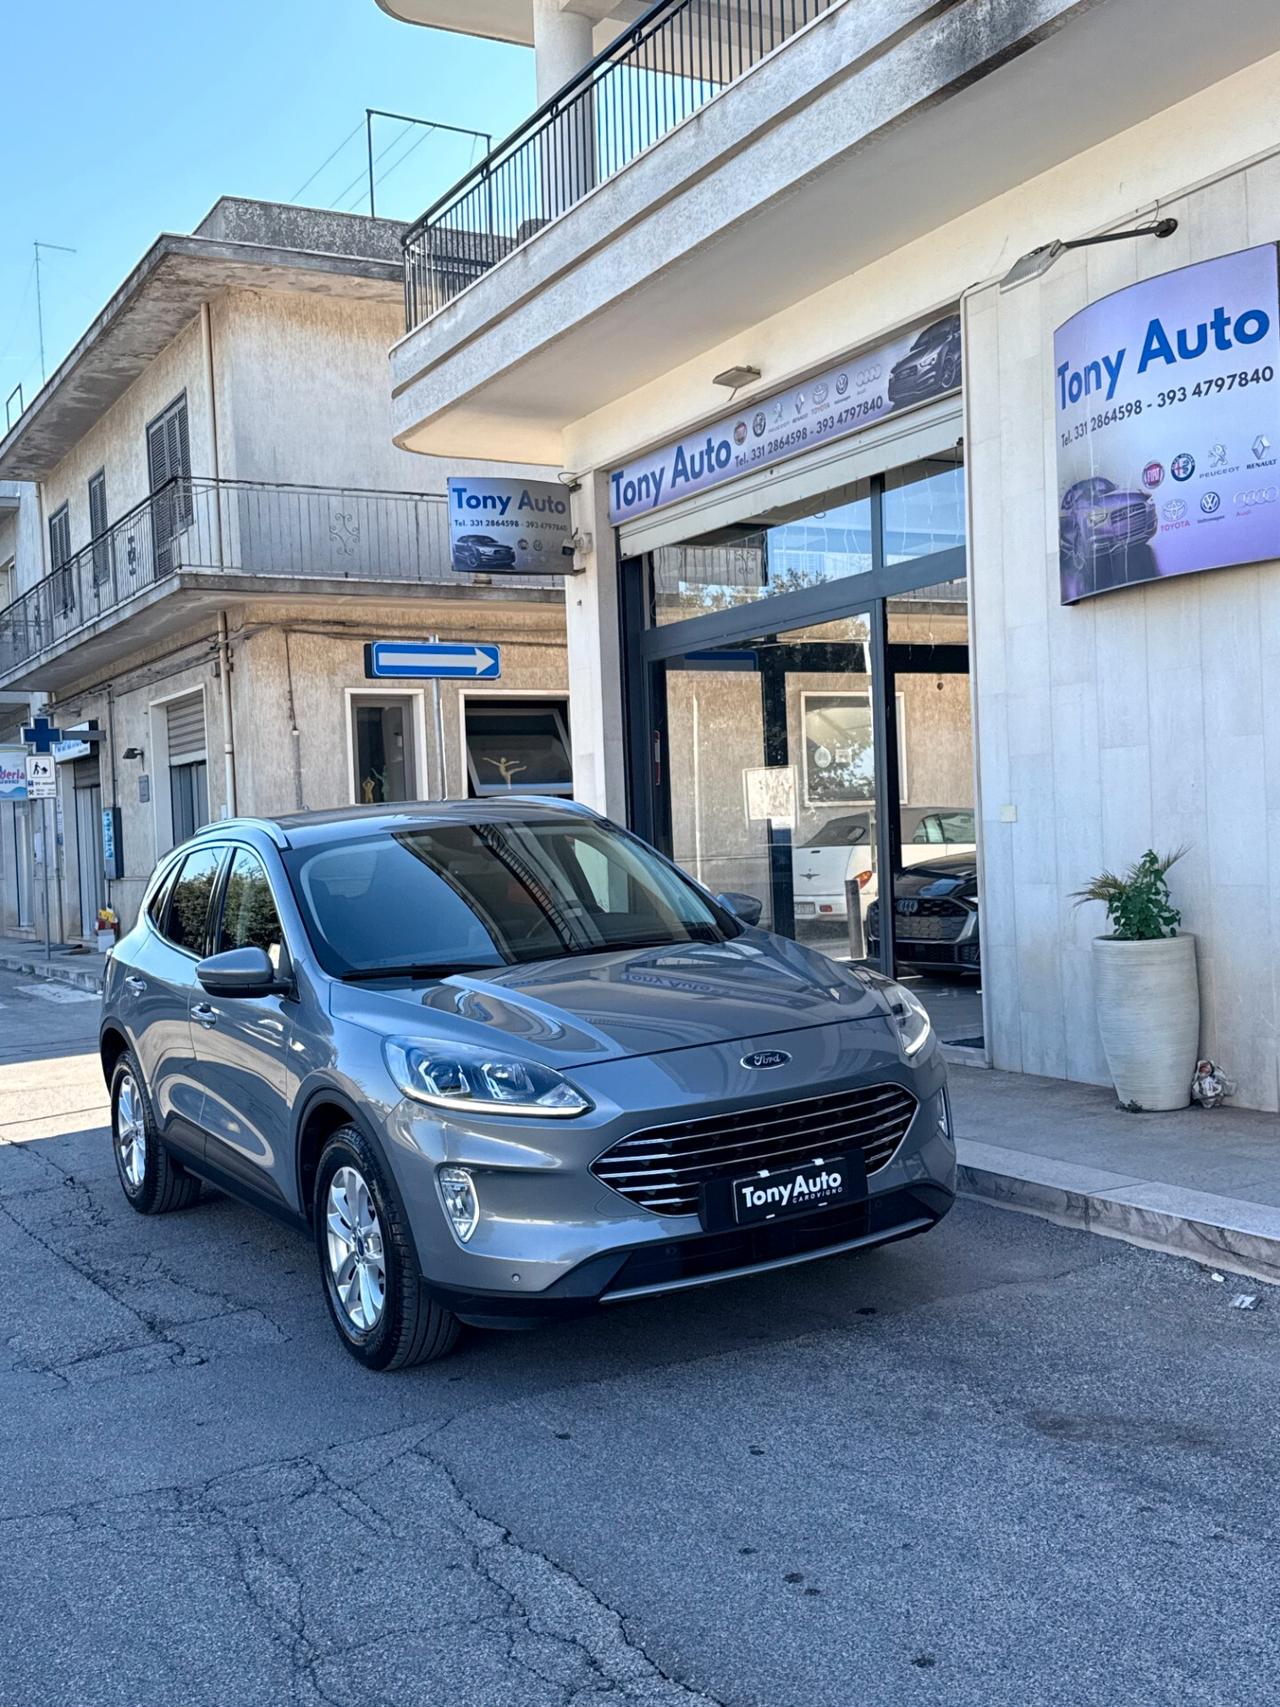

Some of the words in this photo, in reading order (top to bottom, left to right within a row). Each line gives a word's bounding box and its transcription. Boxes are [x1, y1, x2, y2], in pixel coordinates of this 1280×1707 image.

[1057, 348, 1126, 410] Tony
[1137, 307, 1270, 374] Auto
[1061, 430, 1072, 448] Tel.
[1074, 421, 1088, 440] 331
[1091, 400, 1143, 432] 2864598
[1157, 387, 1187, 408] 393
[1191, 366, 1274, 398] 4797840
[735, 454, 749, 468] Tel.
[751, 445, 765, 461] 331
[768, 428, 808, 455] 2864598
[816, 415, 835, 434] 393
[837, 395, 883, 425] 4797840
[611, 467, 665, 511] Tony
[670, 438, 732, 488] Auto
[1199, 465, 1240, 479] PEUGEOT
[1246, 458, 1278, 470] RENAULT
[452, 488, 512, 516] Tony
[518, 489, 566, 515] Auto
[455, 519, 467, 527] Tel.
[486, 520, 519, 528] 2864598
[1160, 520, 1191, 533] TOYOTA
[741, 1171, 842, 1208] TonyAuto
[792, 1186, 843, 1204] CAROVIGNO
